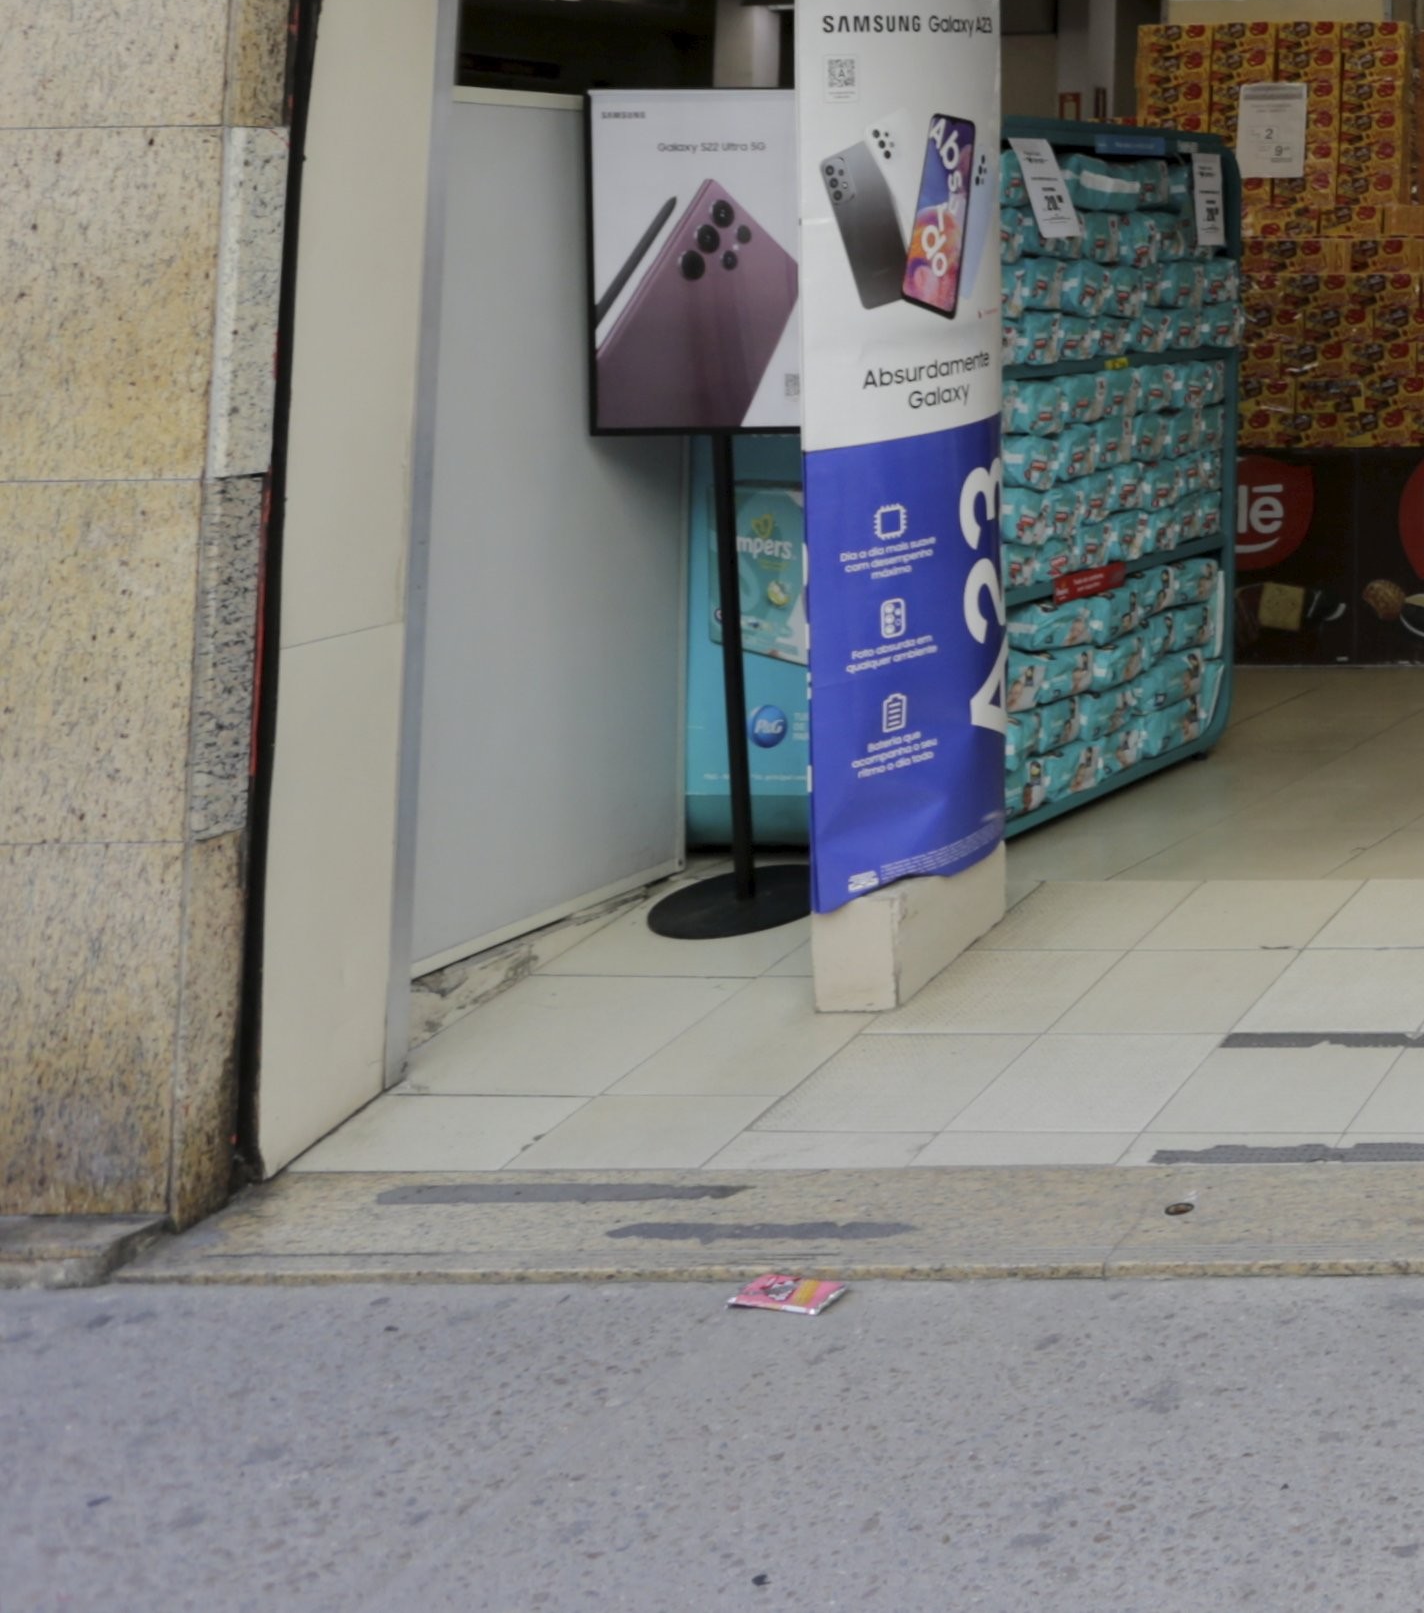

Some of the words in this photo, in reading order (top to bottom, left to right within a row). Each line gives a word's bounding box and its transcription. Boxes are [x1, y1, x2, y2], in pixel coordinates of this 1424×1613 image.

[823, 15, 921, 33] SAMSUNG
[928, 15, 975, 37] Galaxy
[975, 17, 992, 34] A23
[601, 111, 646, 119] SAMSUNG
[1264, 128, 1273, 140] 2
[657, 142, 698, 154] Galaxy
[700, 143, 719, 152] S22
[721, 142, 748, 152] Ultra
[863, 352, 990, 389] Absurdamente
[908, 384, 970, 409] Galaxy
[840, 552, 858, 562] Dia
[868, 547, 884, 557] dia
